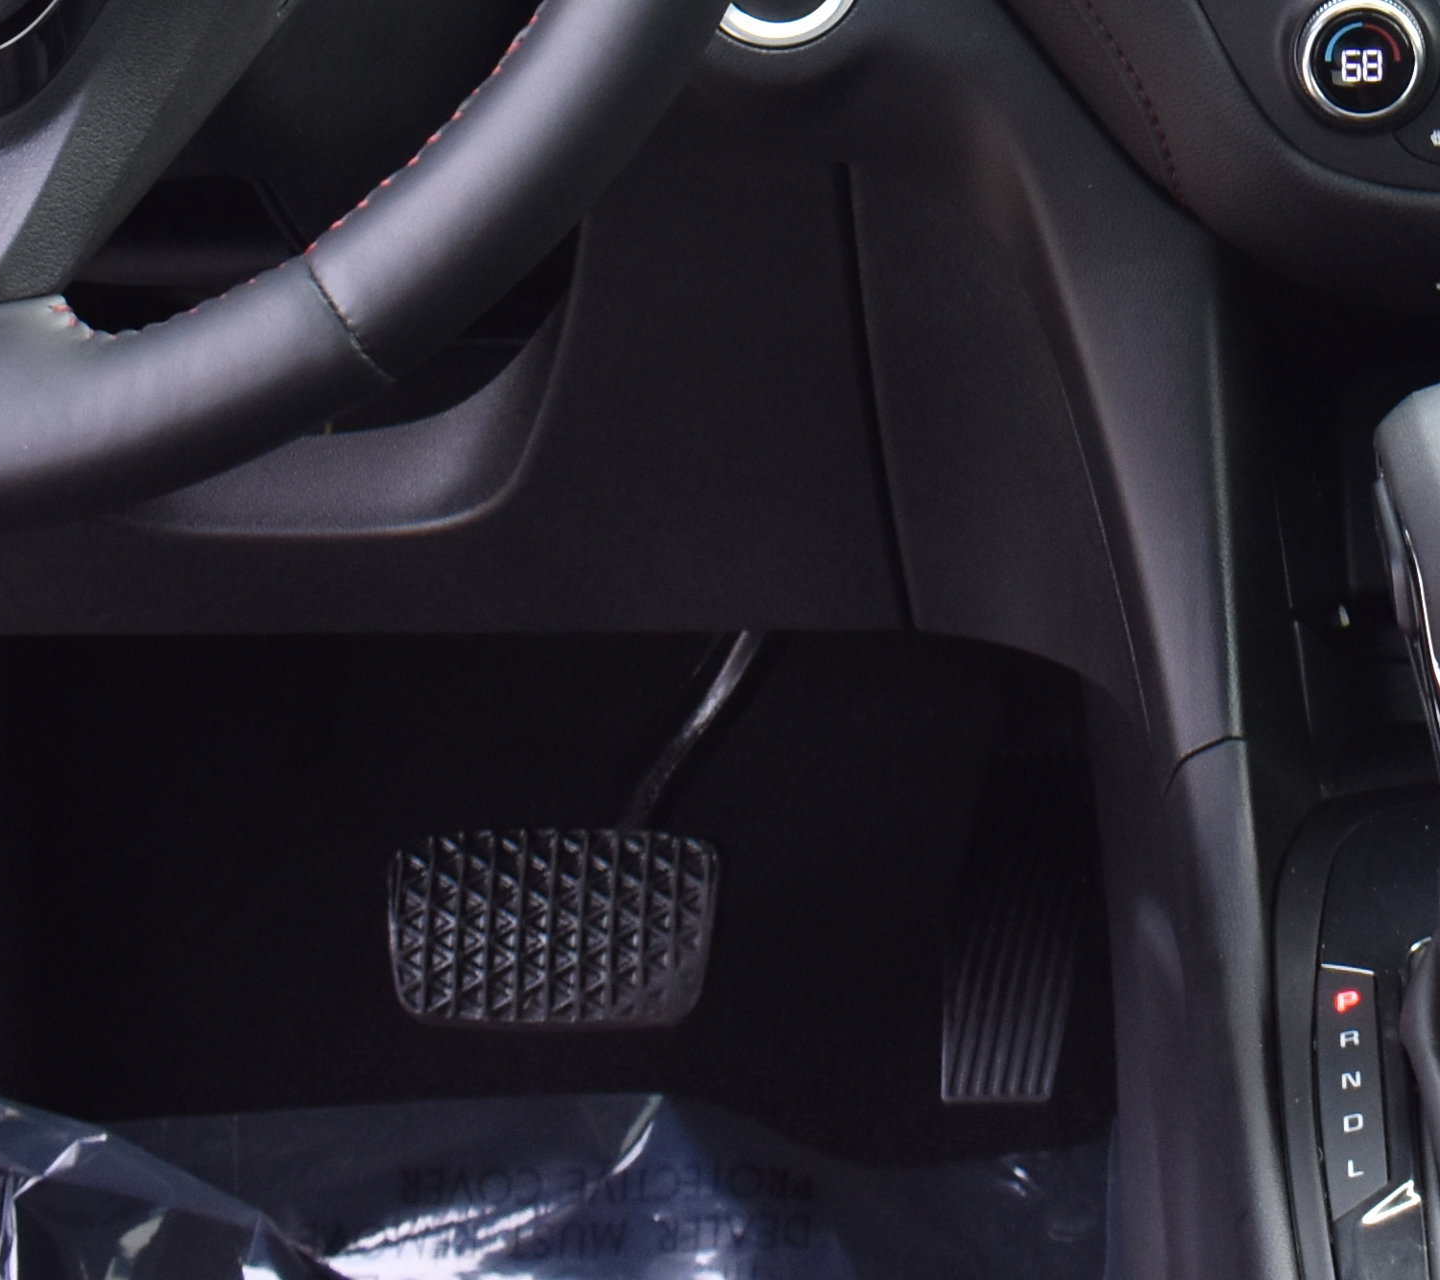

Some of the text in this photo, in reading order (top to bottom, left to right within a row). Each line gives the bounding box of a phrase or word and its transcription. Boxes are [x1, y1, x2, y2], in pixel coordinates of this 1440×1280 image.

[1340, 48, 1384, 83] 68
[1335, 991, 1360, 1012] P
[1339, 1030, 1360, 1049] R
[1341, 1070, 1362, 1090] N
[1343, 1113, 1364, 1133] D
[1346, 1159, 1365, 1178] L
[400, 1165, 542, 1204] COVER
